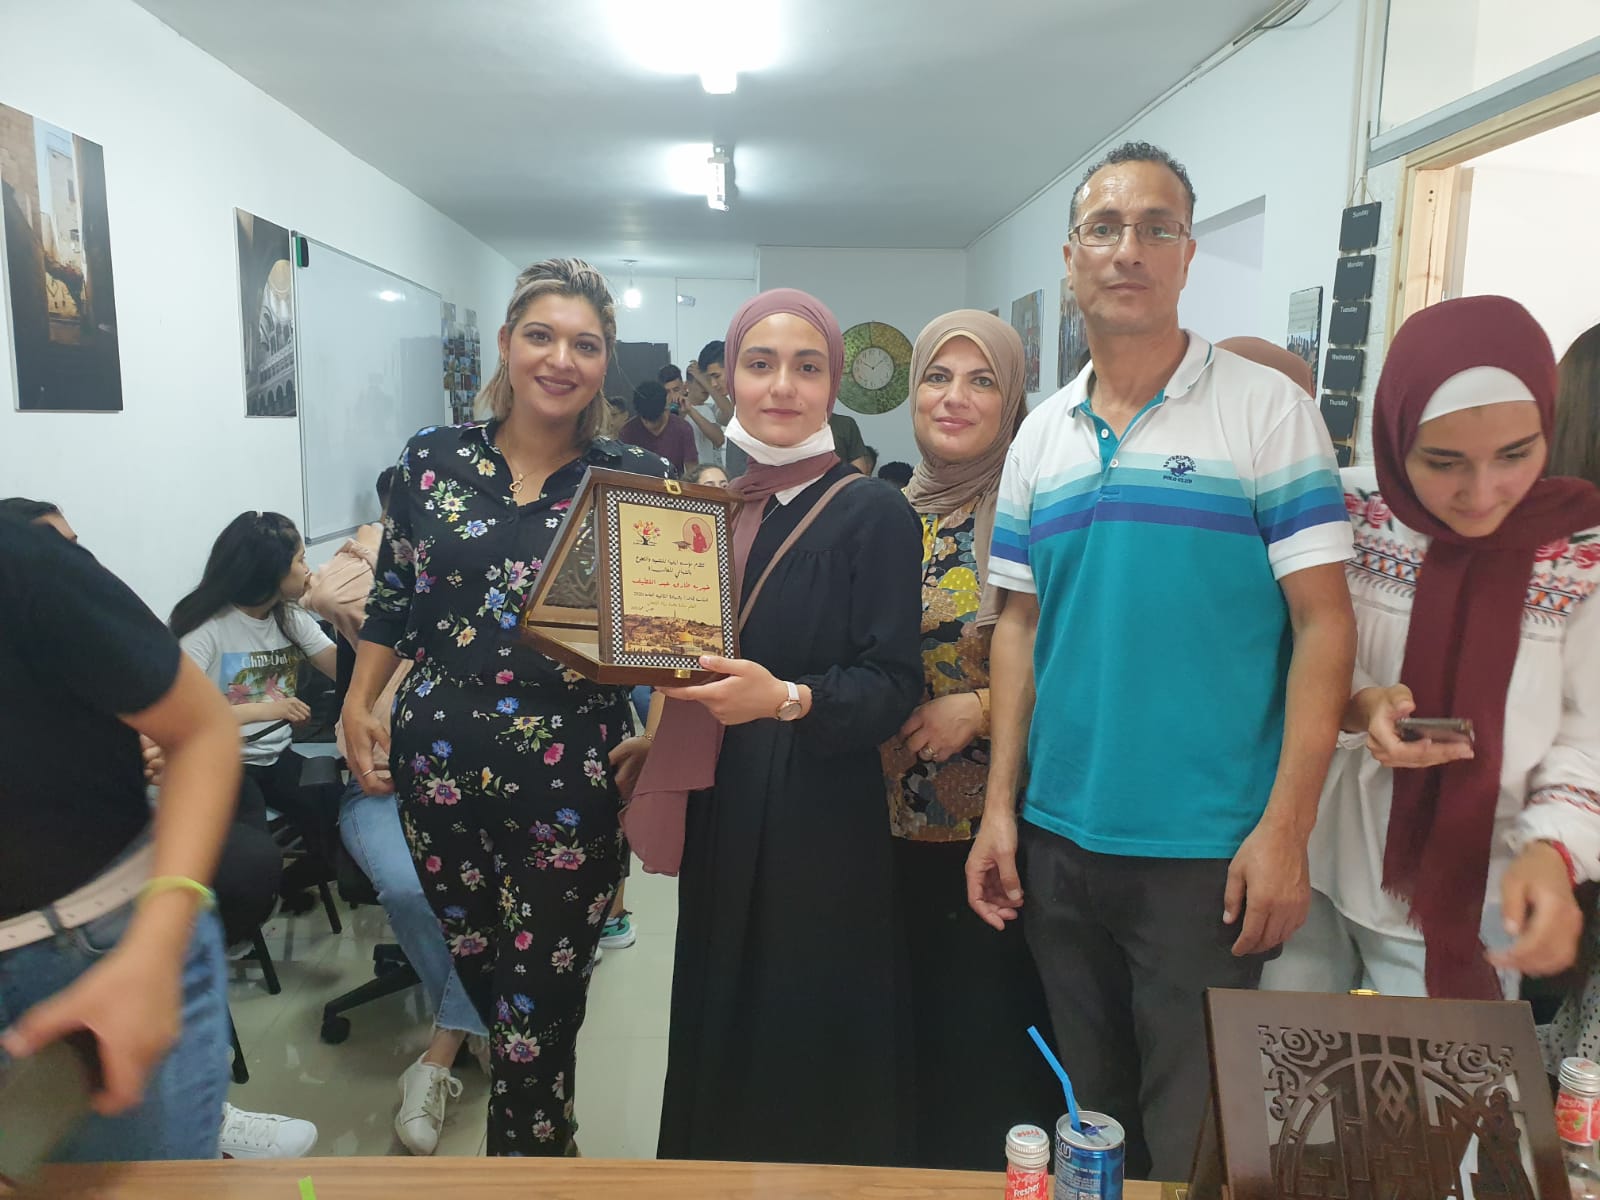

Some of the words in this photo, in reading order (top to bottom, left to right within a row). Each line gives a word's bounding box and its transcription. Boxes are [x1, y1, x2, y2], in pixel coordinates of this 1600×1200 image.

[1352, 209, 1369, 219] Sunday
[1347, 261, 1365, 269] Monday
[1331, 353, 1355, 361] Wednesday
[1329, 399, 1348, 407] Thursday
